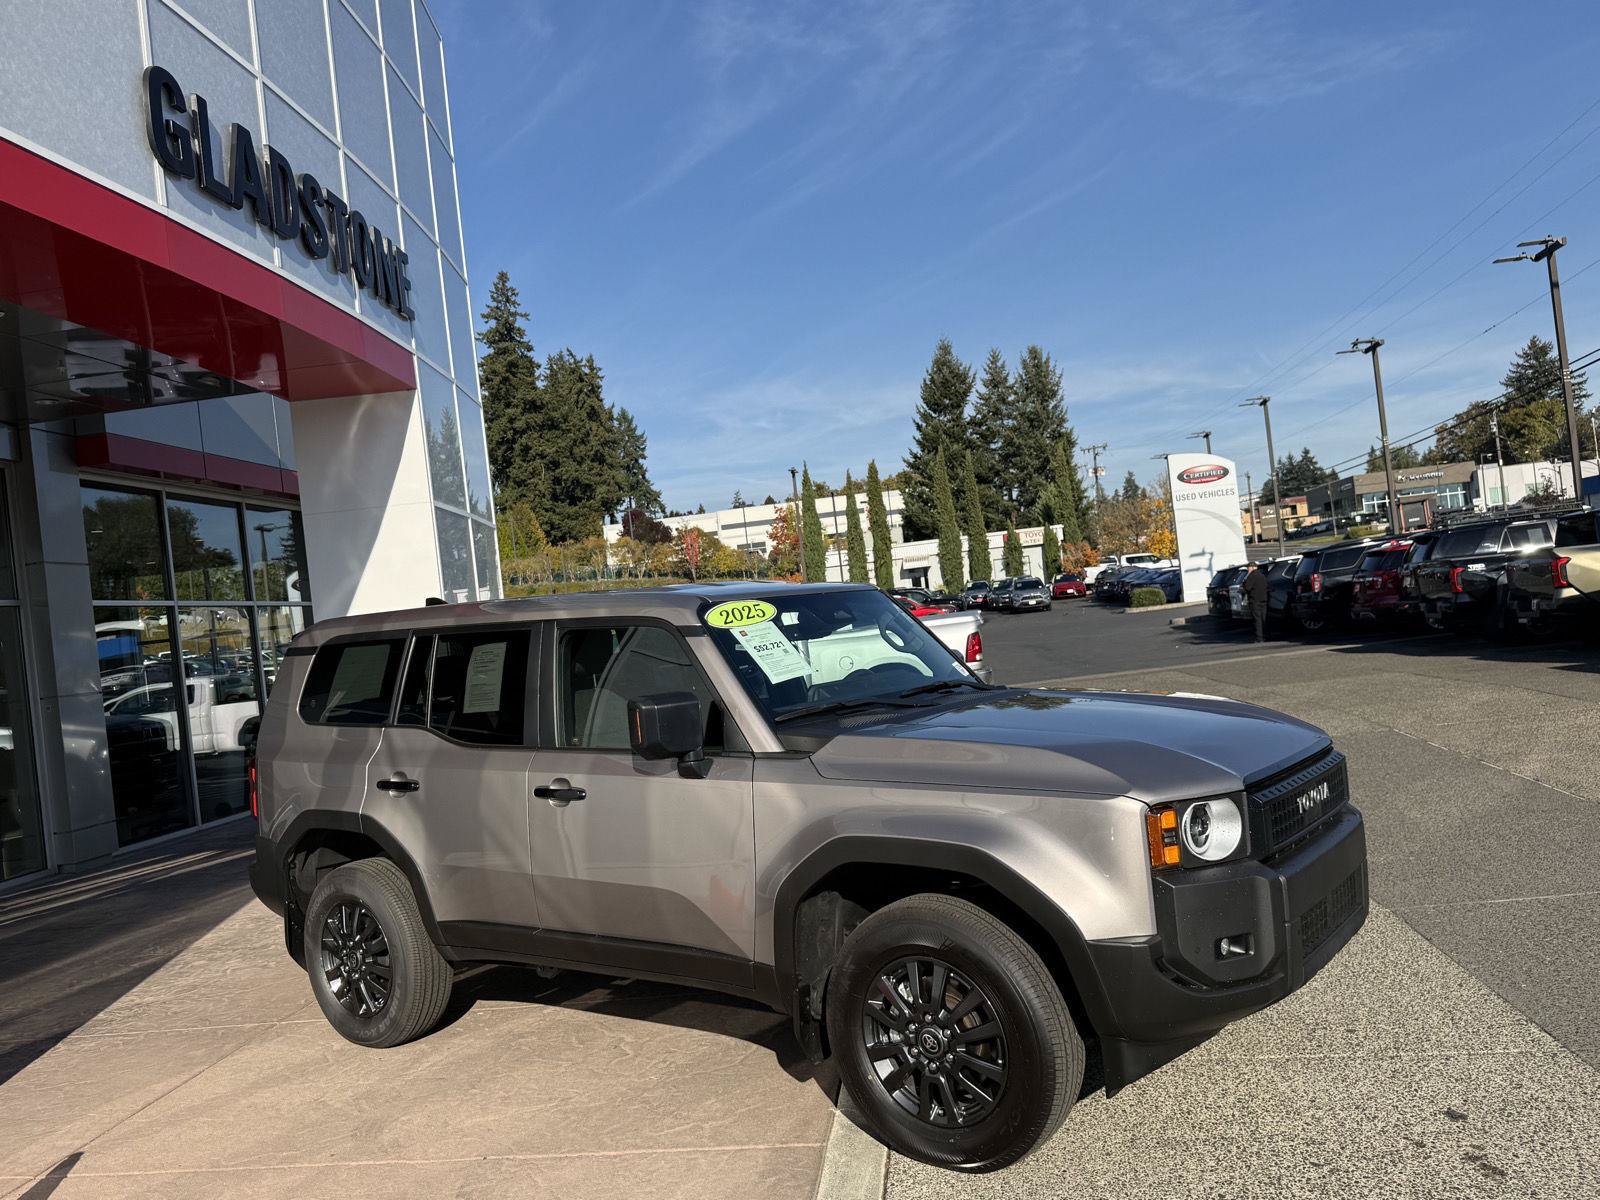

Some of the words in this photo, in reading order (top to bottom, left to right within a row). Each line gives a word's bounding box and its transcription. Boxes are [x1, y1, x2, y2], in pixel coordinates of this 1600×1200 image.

[143, 65, 416, 321] GLADSTONE
[1183, 469, 1224, 479] CERTIFIED
[1175, 492, 1197, 502] USED
[1198, 488, 1235, 499] VEHICLES
[720, 604, 766, 625] 2025
[753, 640, 785, 653] $52,721
[1296, 782, 1330, 814] TOYOTA
